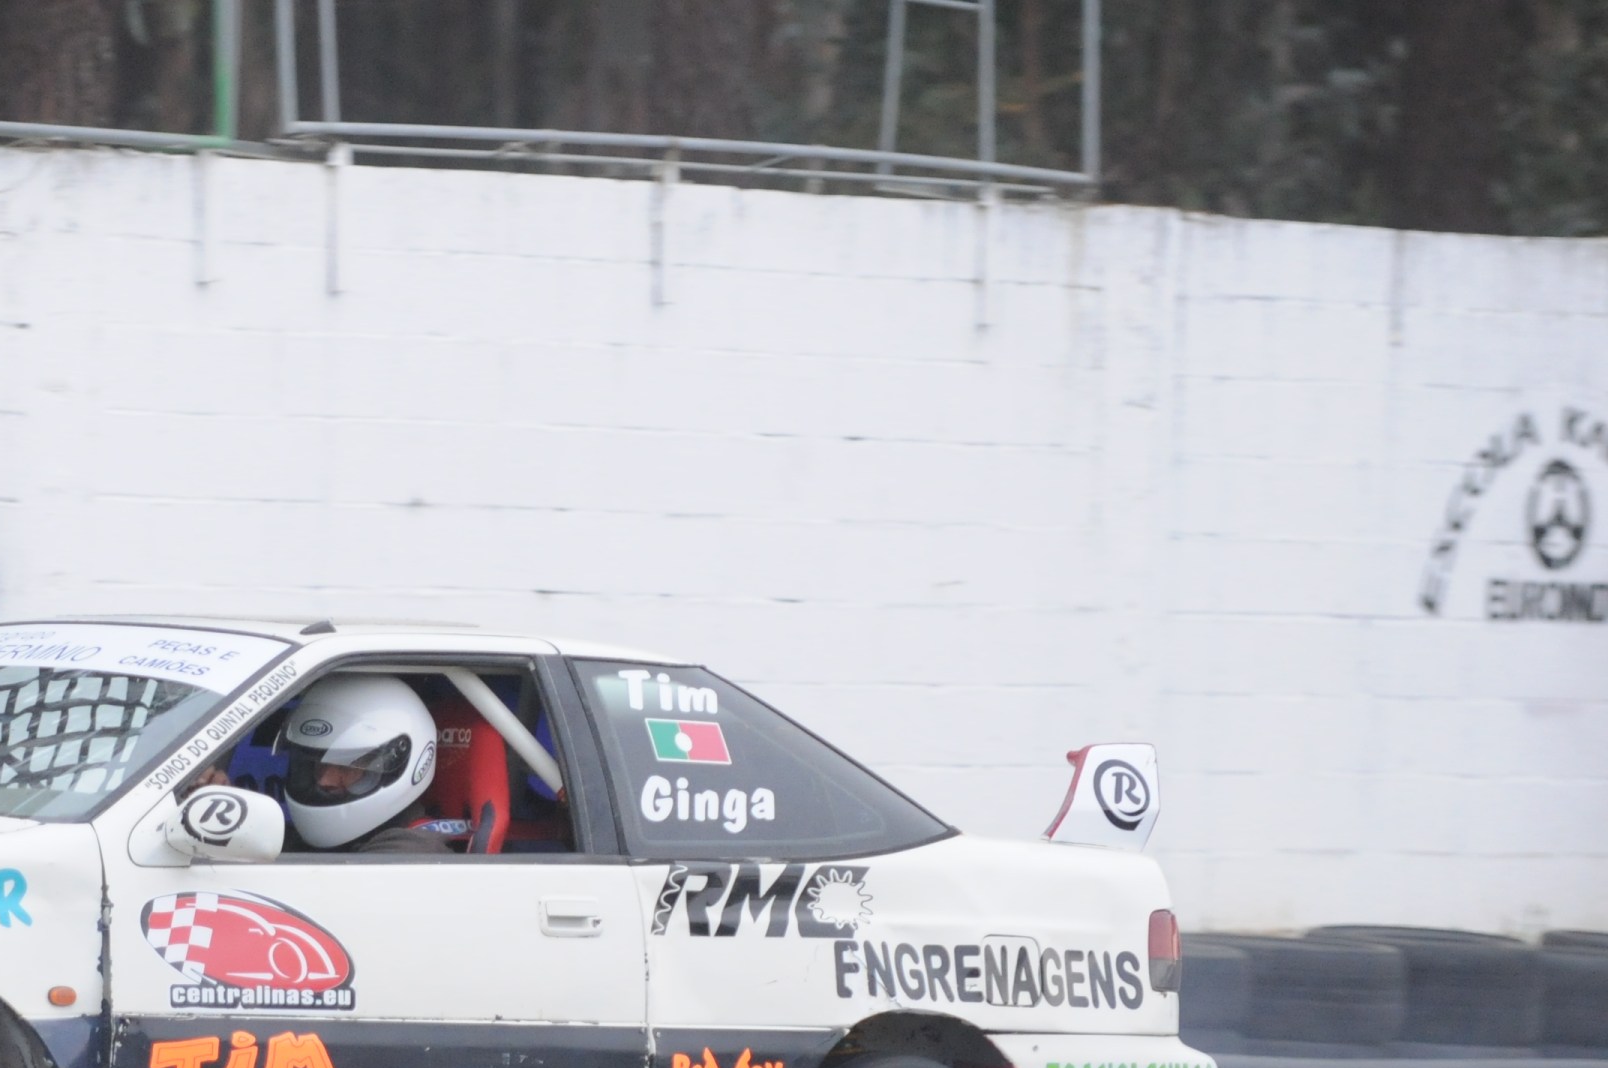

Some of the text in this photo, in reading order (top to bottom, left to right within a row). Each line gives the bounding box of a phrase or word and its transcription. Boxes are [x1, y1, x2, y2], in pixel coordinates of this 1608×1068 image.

[1488, 577, 1608, 622] EUROIND
[118, 655, 211, 677] CAMIÕES
[148, 639, 240, 661] PEÇAS E
[618, 669, 718, 714] Tim
[187, 737, 209, 759] DO
[206, 701, 253, 741] QUINTAL
[436, 727, 472, 745] parco
[641, 775, 775, 834] Ginga
[171, 985, 352, 1007] centralinas.eu
[834, 940, 1144, 1010] ENGRENAGENS
